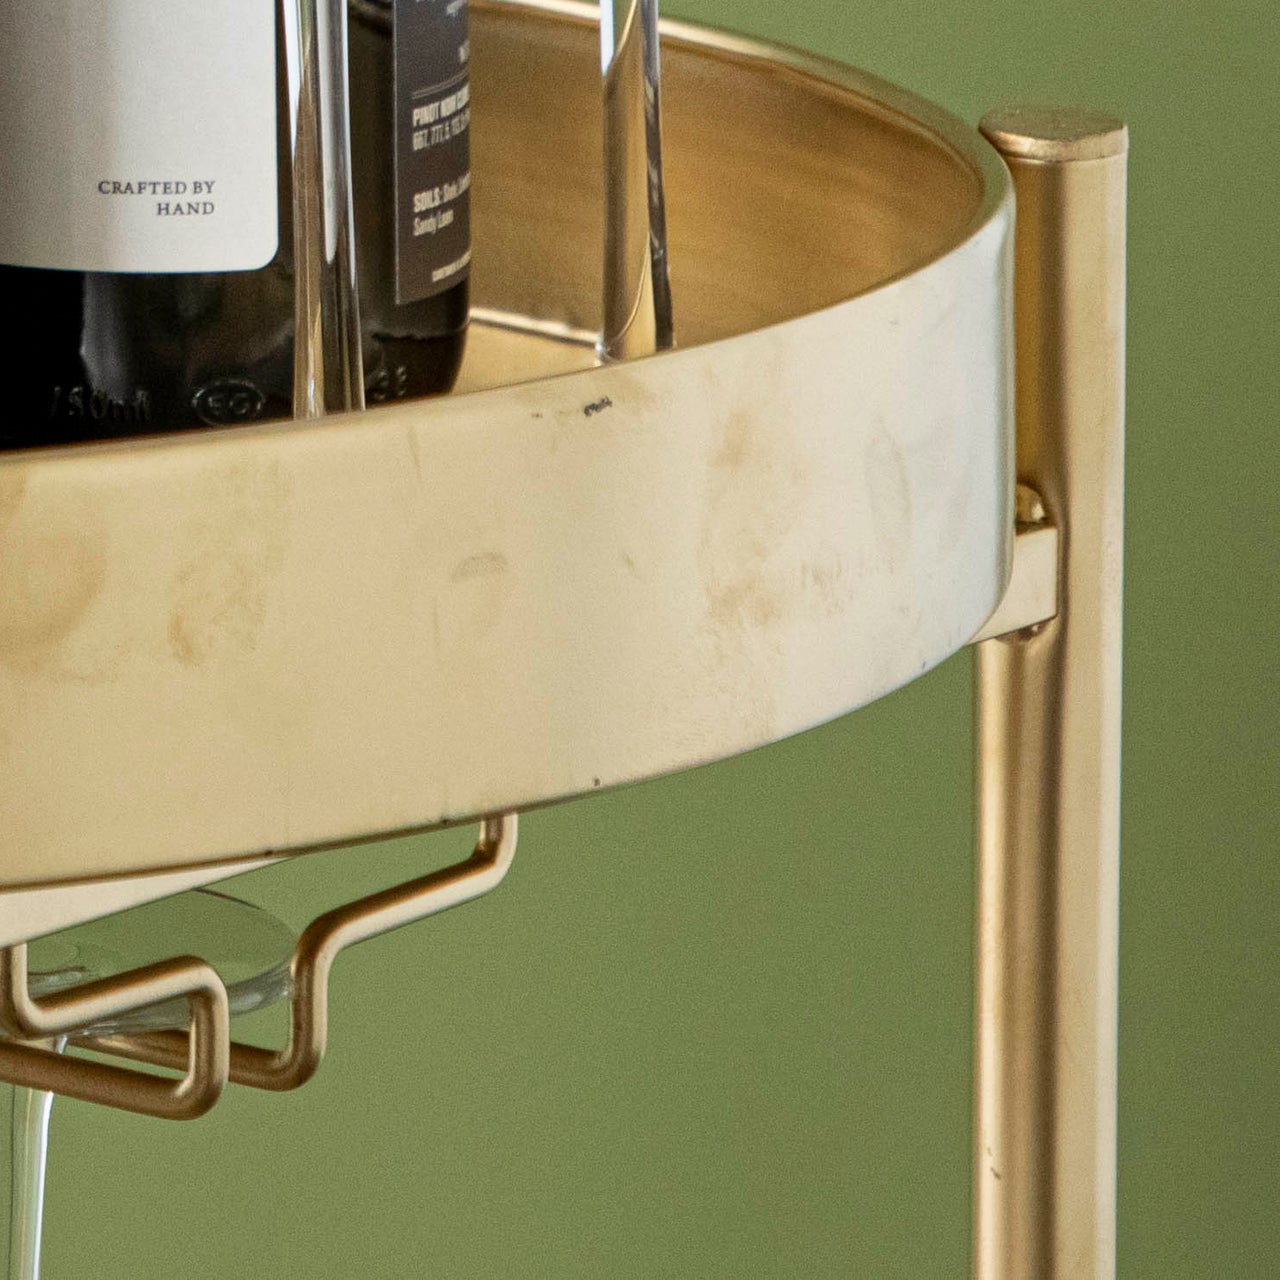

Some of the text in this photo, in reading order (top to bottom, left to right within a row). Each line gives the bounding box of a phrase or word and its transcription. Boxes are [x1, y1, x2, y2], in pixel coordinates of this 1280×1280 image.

[98, 180, 216, 195] CRAFTED BY
[157, 202, 216, 216] HAND
